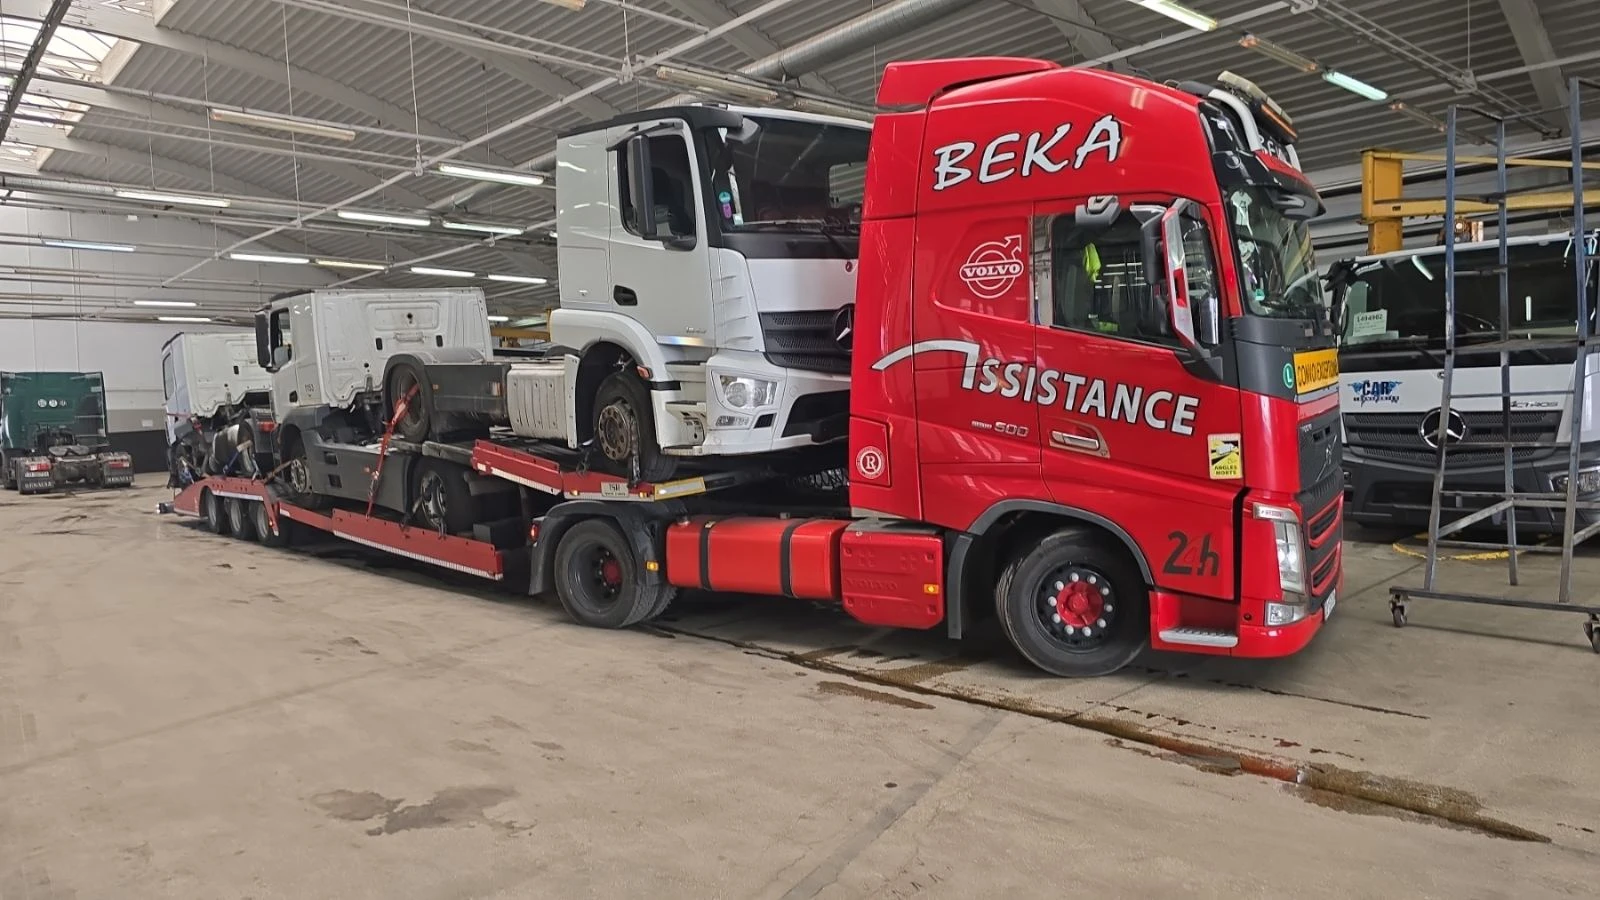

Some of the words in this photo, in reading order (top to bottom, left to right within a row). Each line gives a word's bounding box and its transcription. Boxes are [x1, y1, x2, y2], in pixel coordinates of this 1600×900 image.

[933, 114, 1121, 191] BEKA
[963, 262, 1021, 278] VOLVO
[1286, 367, 1293, 383] L
[1362, 380, 1393, 396] CAR
[994, 421, 1029, 438] 500
[865, 455, 877, 470] R
